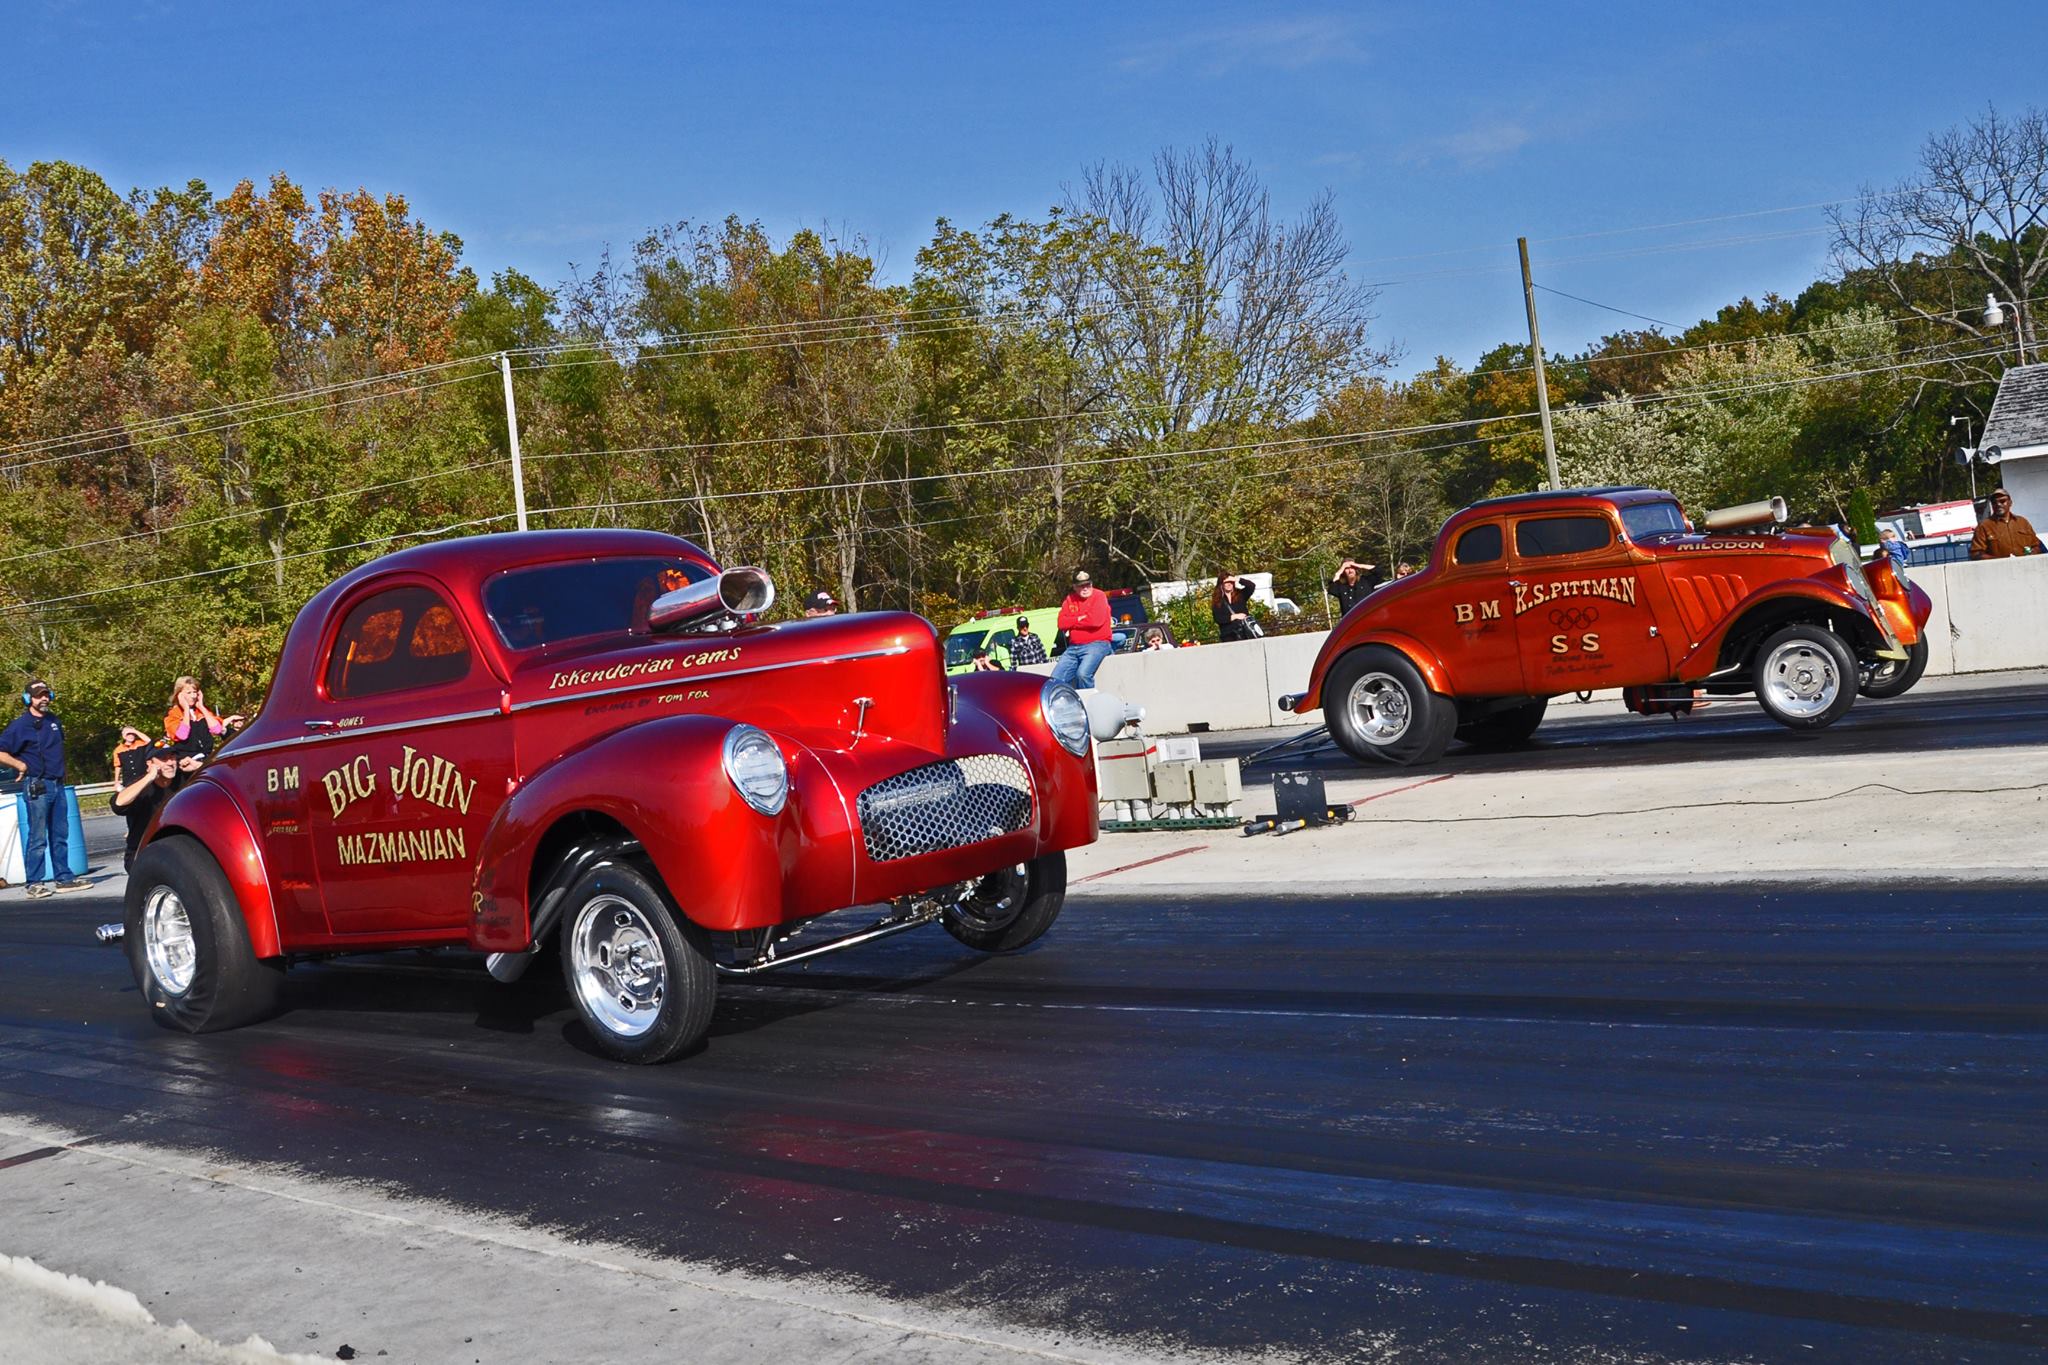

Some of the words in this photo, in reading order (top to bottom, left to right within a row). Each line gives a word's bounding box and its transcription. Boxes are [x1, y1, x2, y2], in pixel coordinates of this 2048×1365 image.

[1677, 541, 1765, 551] MILODON
[549, 658, 674, 689] Iskenderian
[682, 646, 742, 668] cams
[657, 694, 683, 704] TOM
[687, 690, 710, 700] FOX
[321, 754, 376, 819] BIG
[389, 745, 477, 815] JOHN
[337, 827, 466, 865] MAZMANIAN
